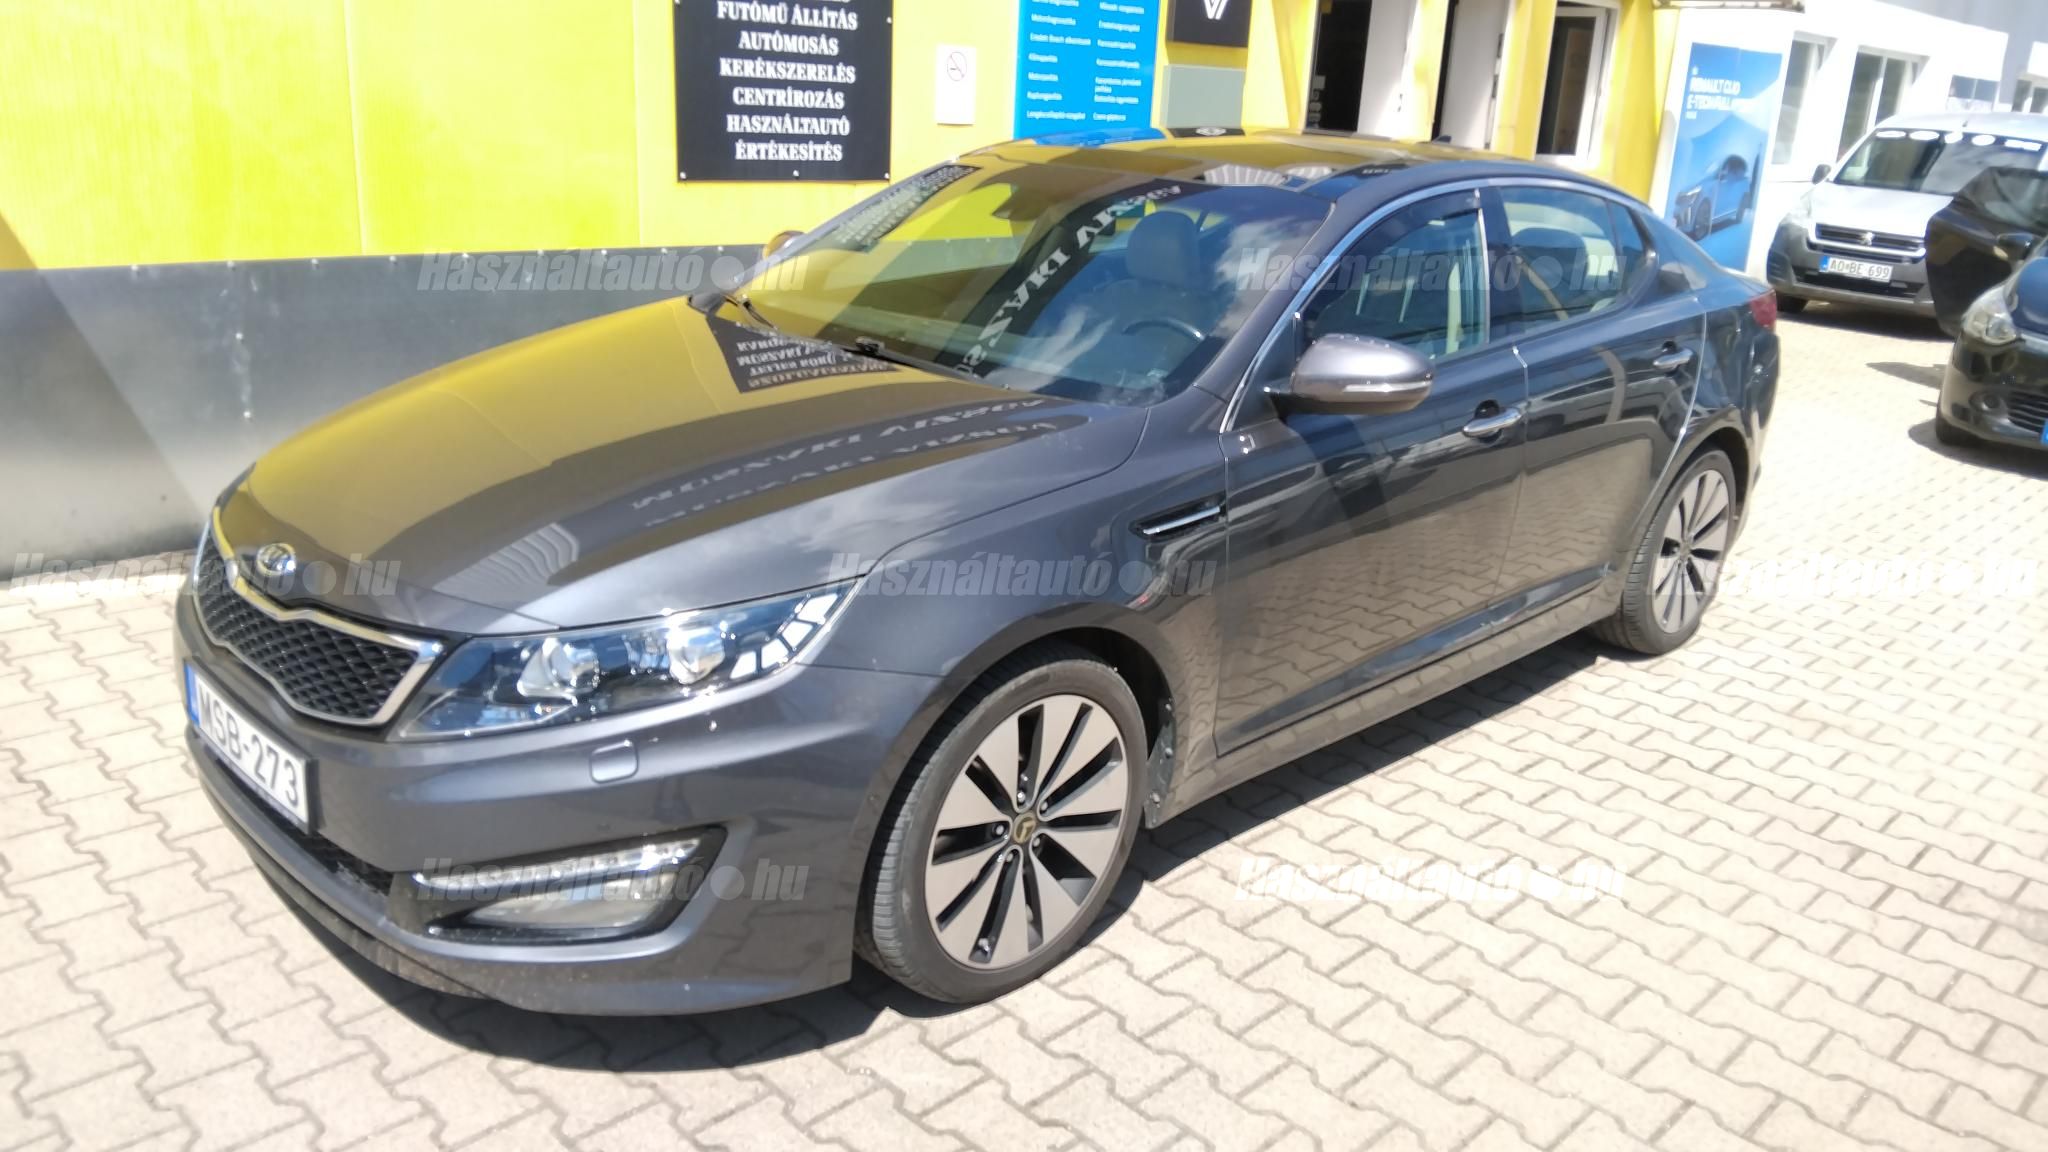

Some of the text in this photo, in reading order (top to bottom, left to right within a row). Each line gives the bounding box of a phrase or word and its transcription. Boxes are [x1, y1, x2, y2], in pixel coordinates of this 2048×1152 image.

[717, 0, 859, 31] FUTÓMŰ ÁLLÍTÁS
[738, 29, 840, 56] AUTÓMOSÁS
[719, 56, 857, 84] KERÉKSZERELÉS
[732, 86, 846, 110] CENTRÍROZÁS
[726, 113, 851, 136] HASZNÁLTAUTÓ
[735, 139, 843, 162] ÉRTÉKESÍTÉS
[198, 682, 299, 808] MSB-273
